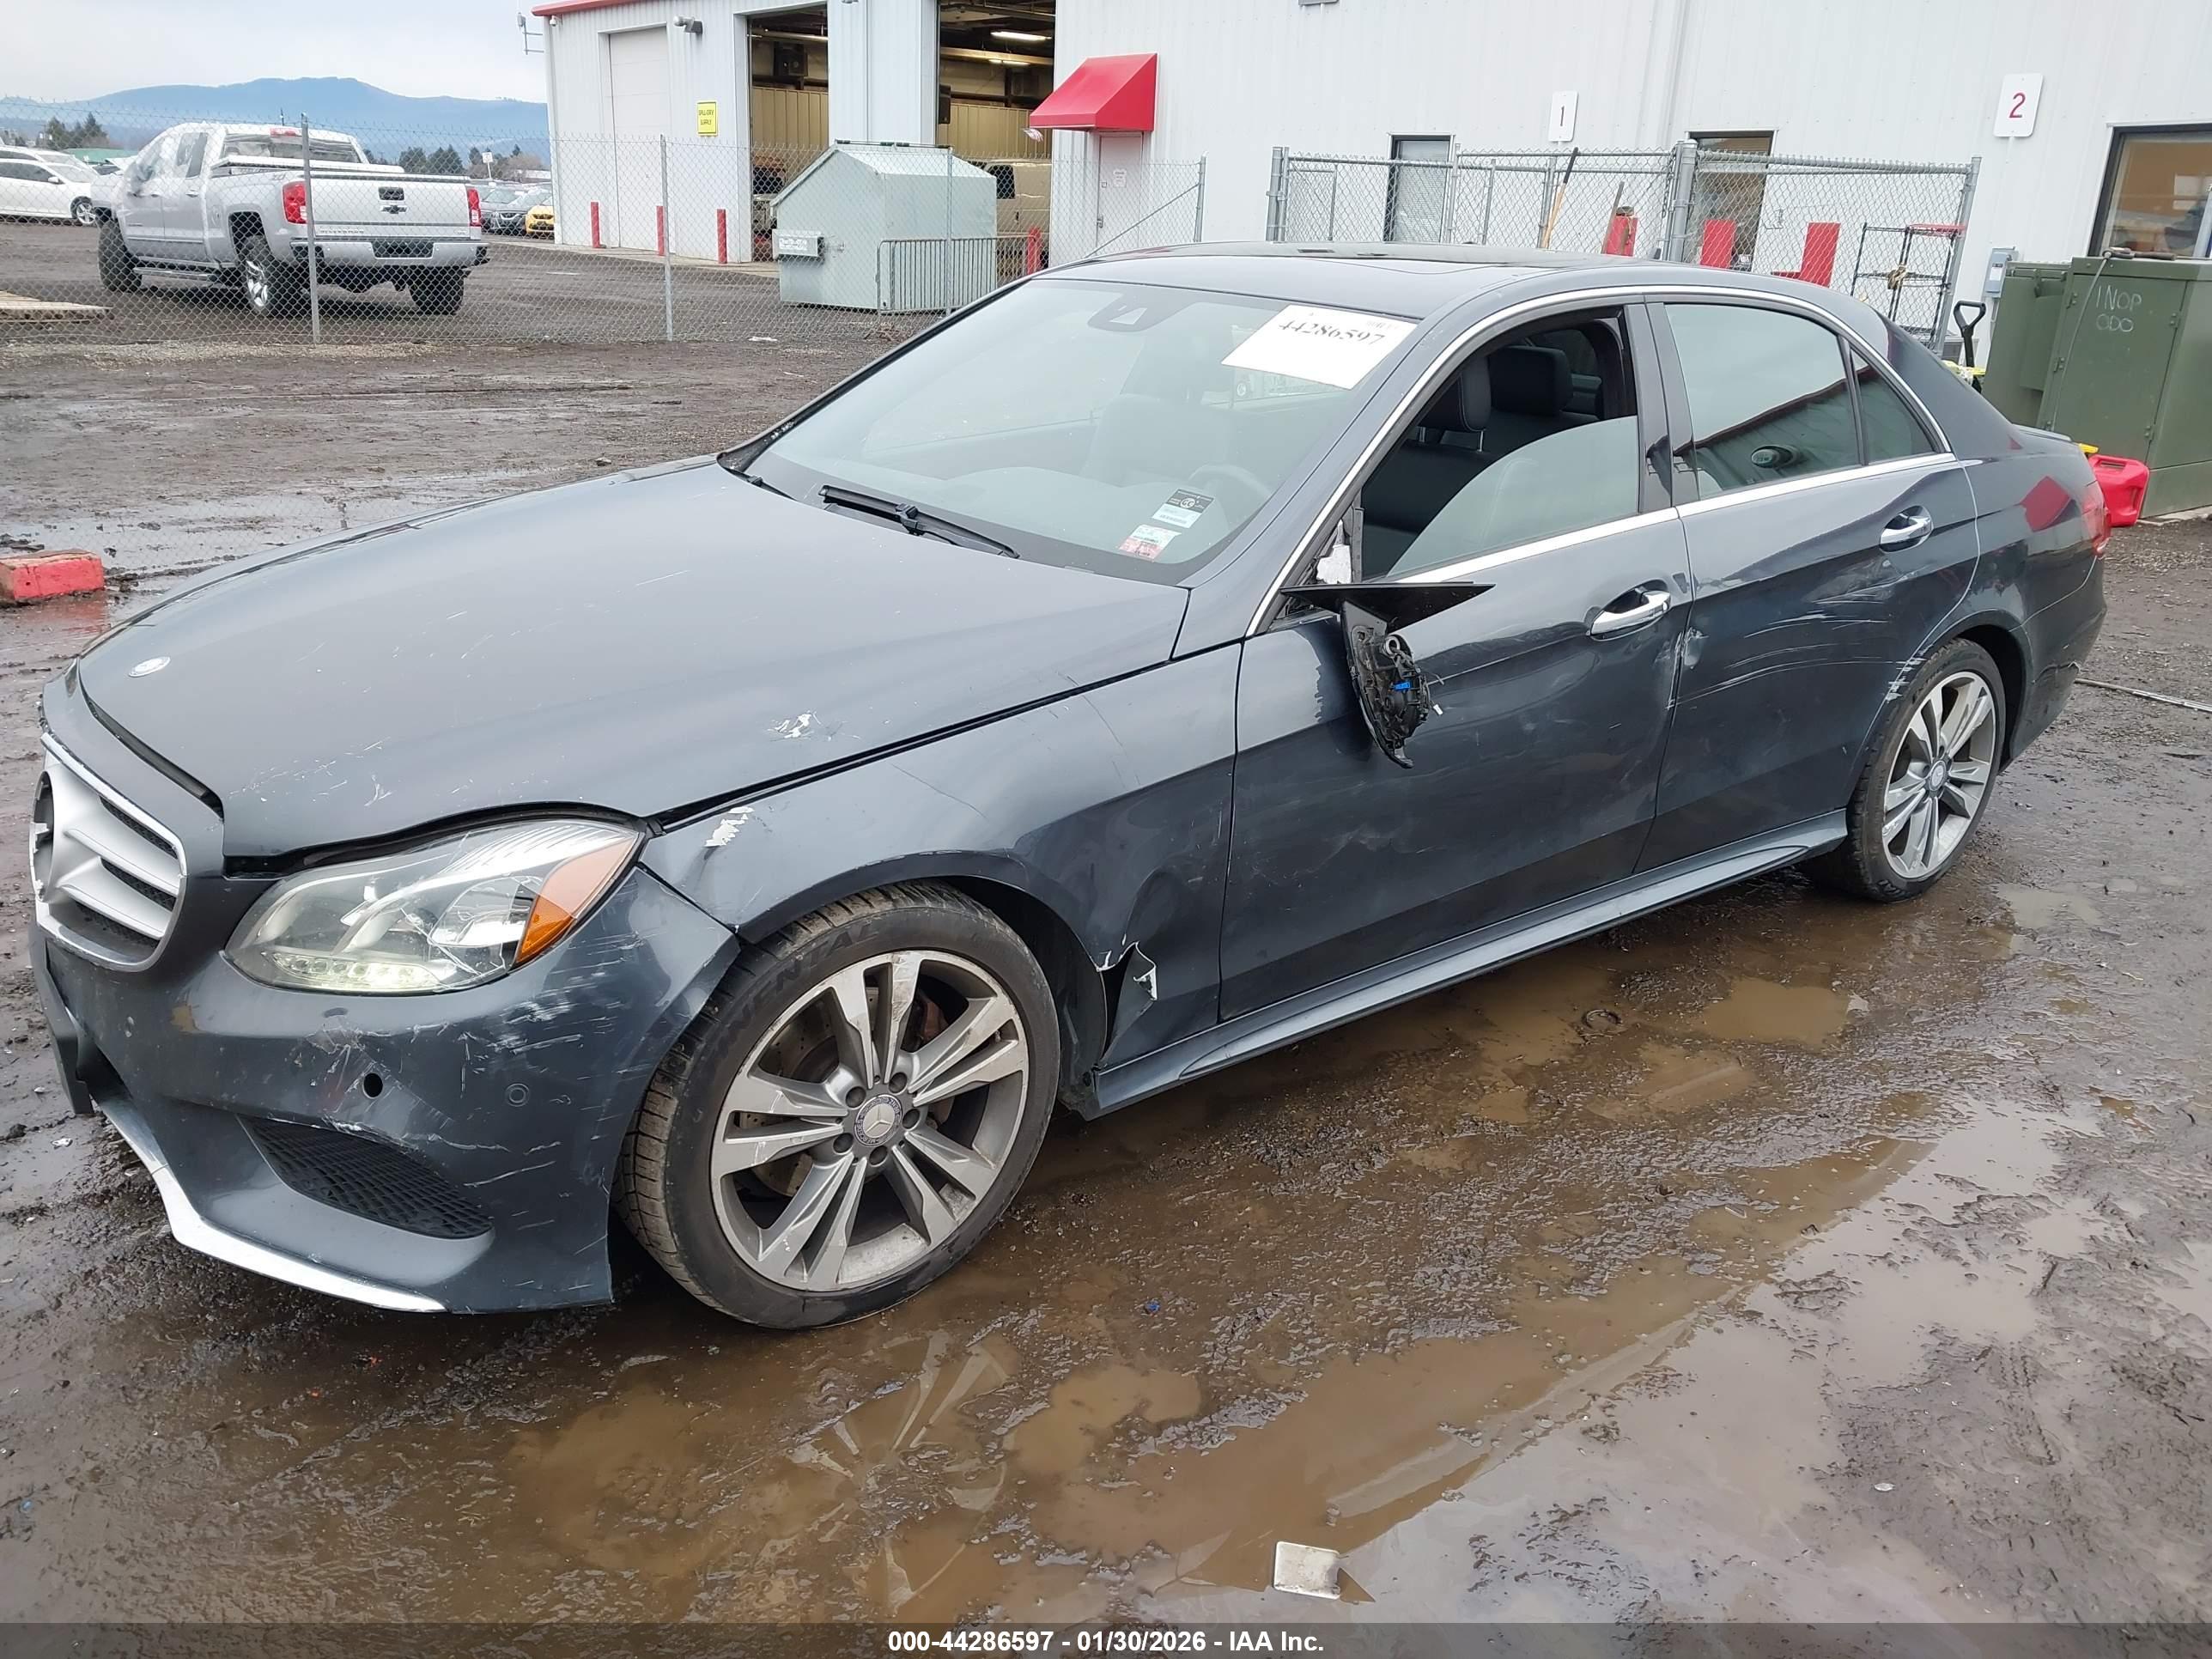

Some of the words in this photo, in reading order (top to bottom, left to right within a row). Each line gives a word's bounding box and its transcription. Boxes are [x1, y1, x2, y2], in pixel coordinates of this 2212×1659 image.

[1559, 105, 1565, 127] 1
[2009, 92, 2027, 118] 2
[2096, 284, 2142, 312] INOP
[1279, 319, 1386, 345] 44286597
